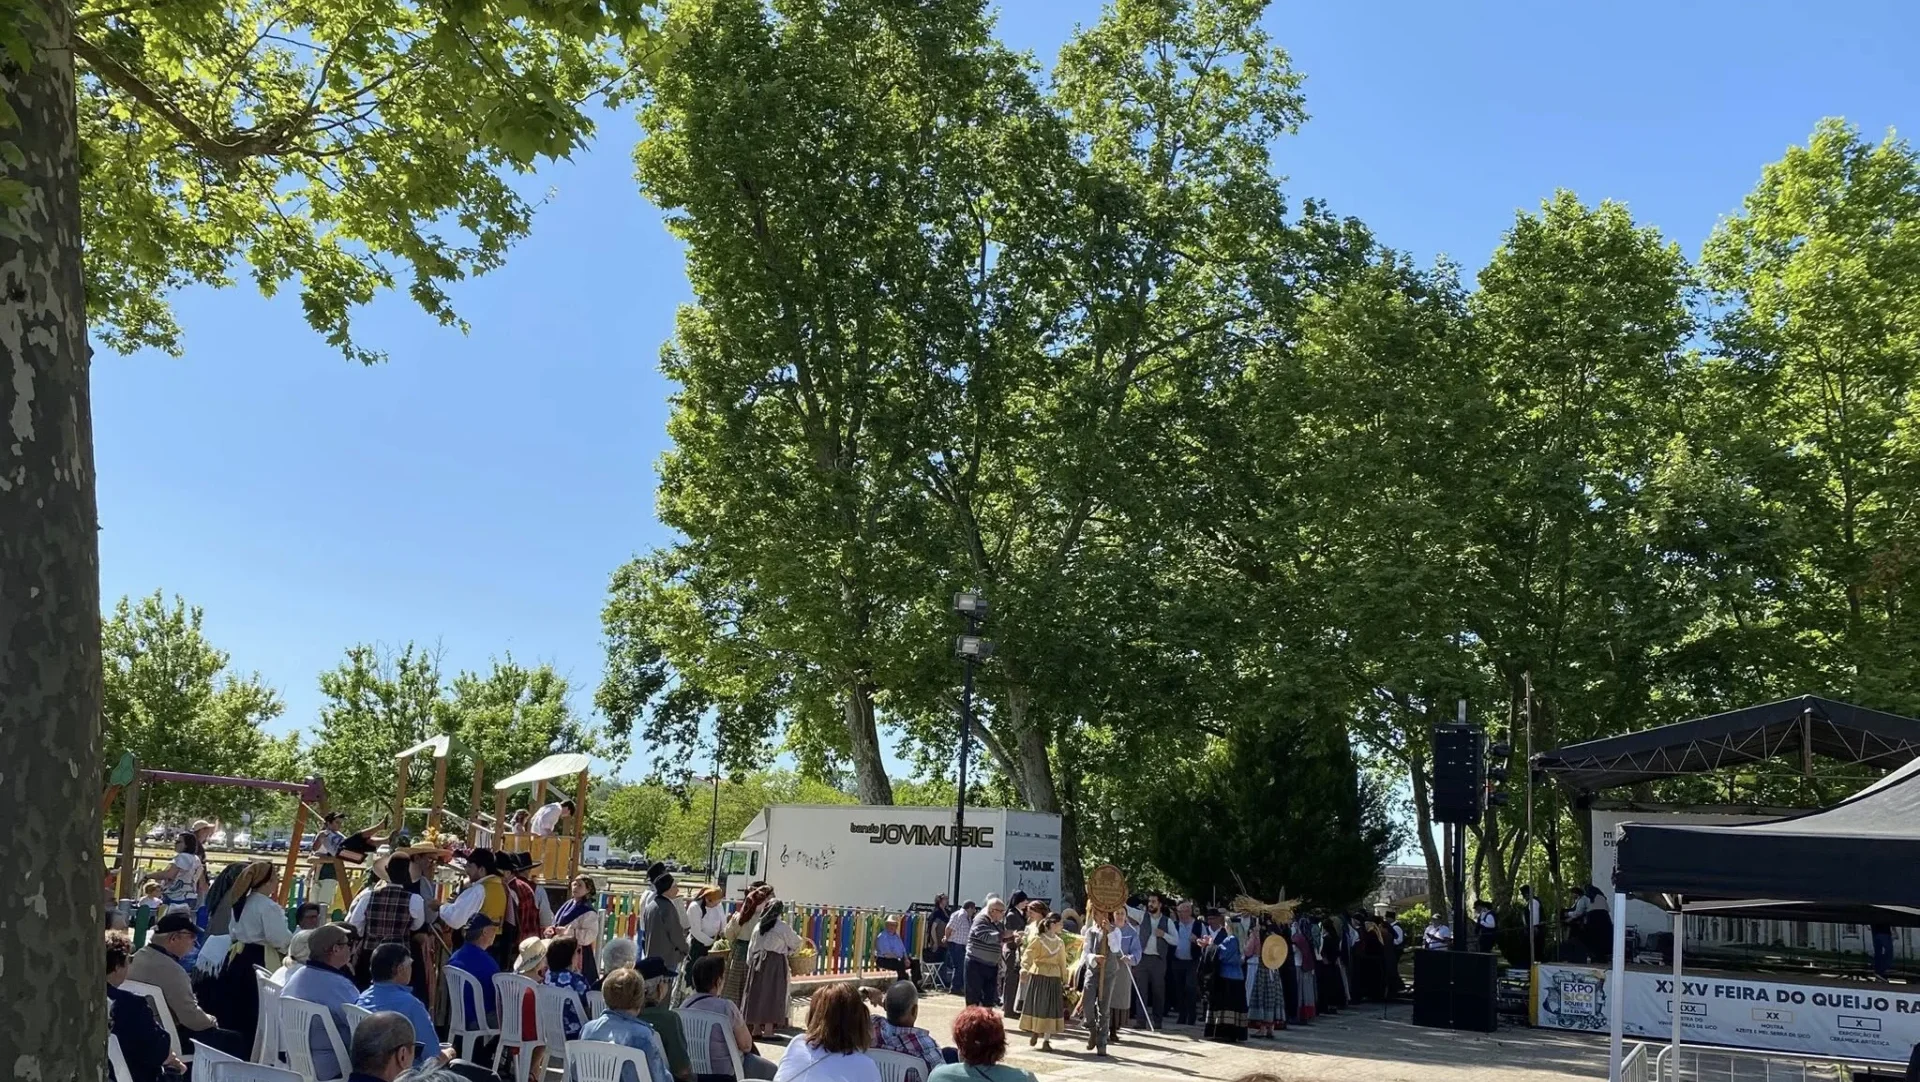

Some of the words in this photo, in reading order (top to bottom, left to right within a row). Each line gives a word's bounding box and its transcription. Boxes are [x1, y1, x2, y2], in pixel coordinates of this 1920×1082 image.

[850, 822, 879, 834] banda
[870, 824, 993, 848] JOVIMUSIC
[1563, 983, 1593, 994] EXPO
[1714, 984, 1770, 1002] FEIRA
[1776, 989, 1806, 1005] DO
[1812, 992, 1889, 1012] QUEIJO
[1766, 1011, 1780, 1020] XX
